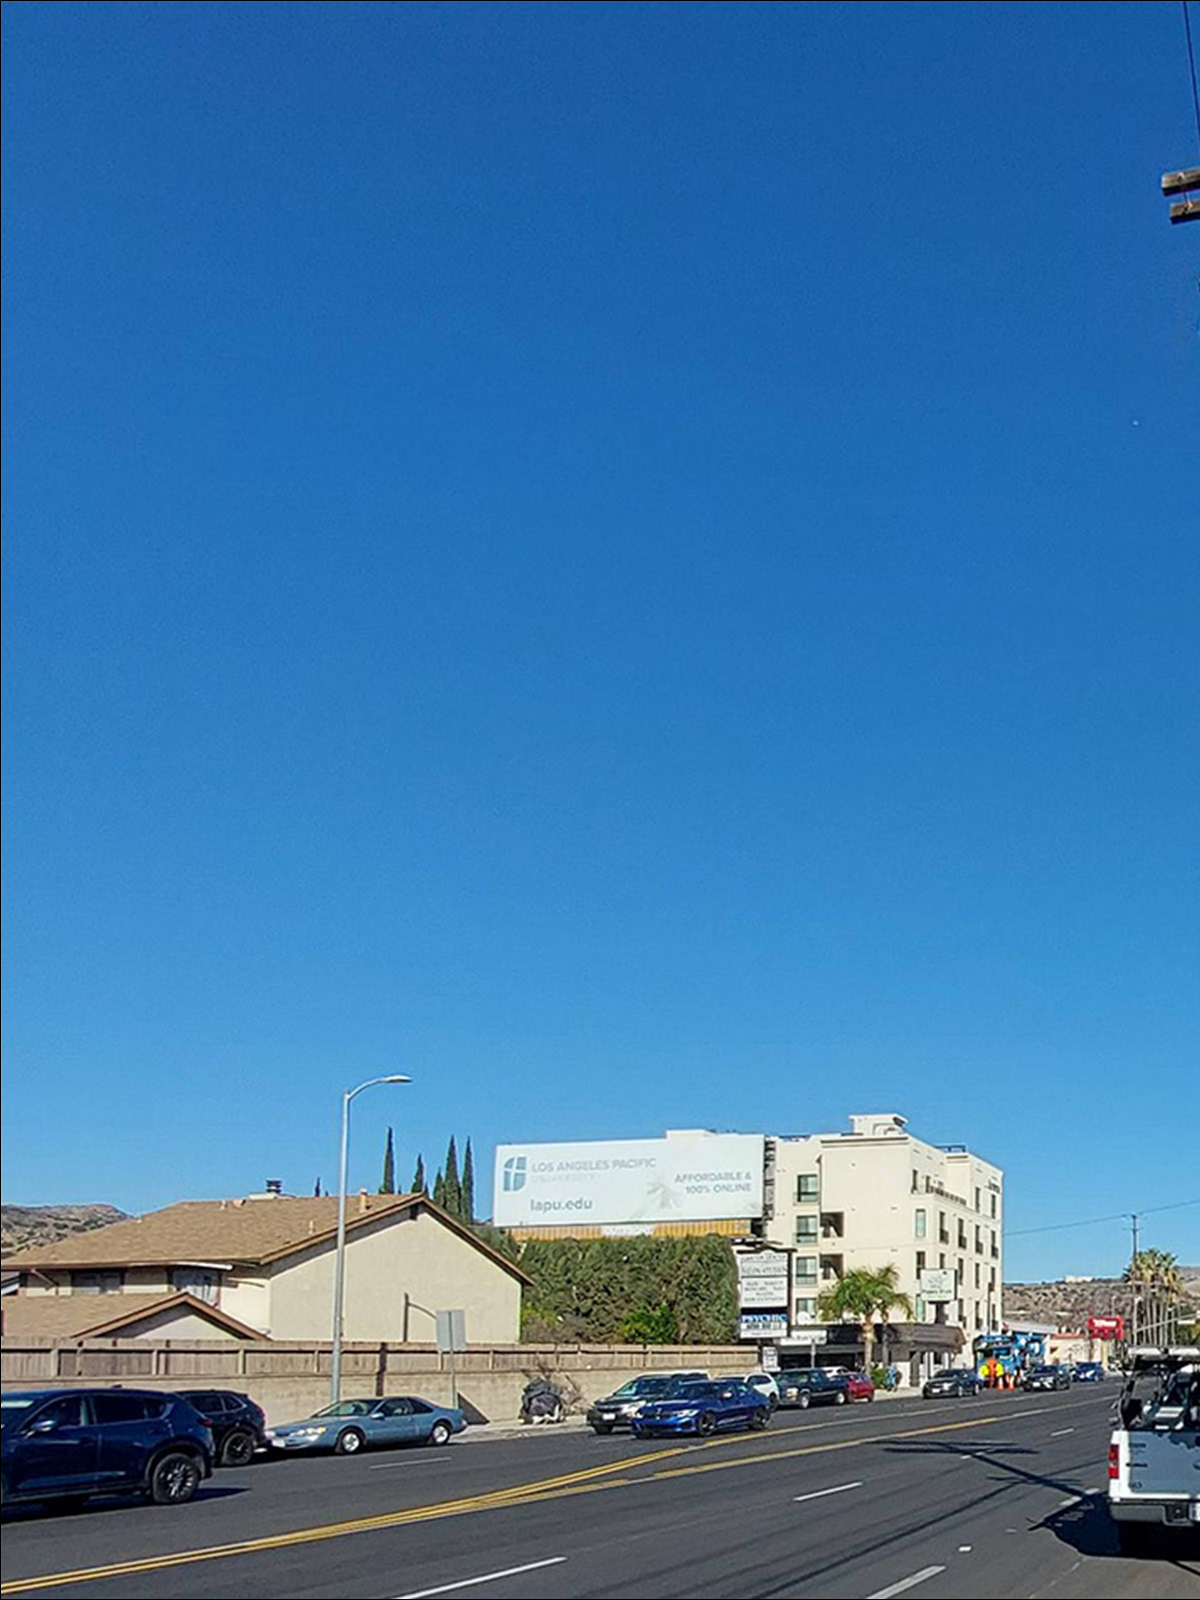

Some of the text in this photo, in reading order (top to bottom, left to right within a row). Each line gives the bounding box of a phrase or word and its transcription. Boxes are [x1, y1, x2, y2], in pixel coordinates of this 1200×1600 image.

[532, 1158, 657, 1173] LOS ANGELES PACIFIC
[674, 1172, 741, 1183] AFFORDABLE
[713, 1183, 752, 1193] ONLINE
[530, 1198, 593, 1213] lapu.edu
